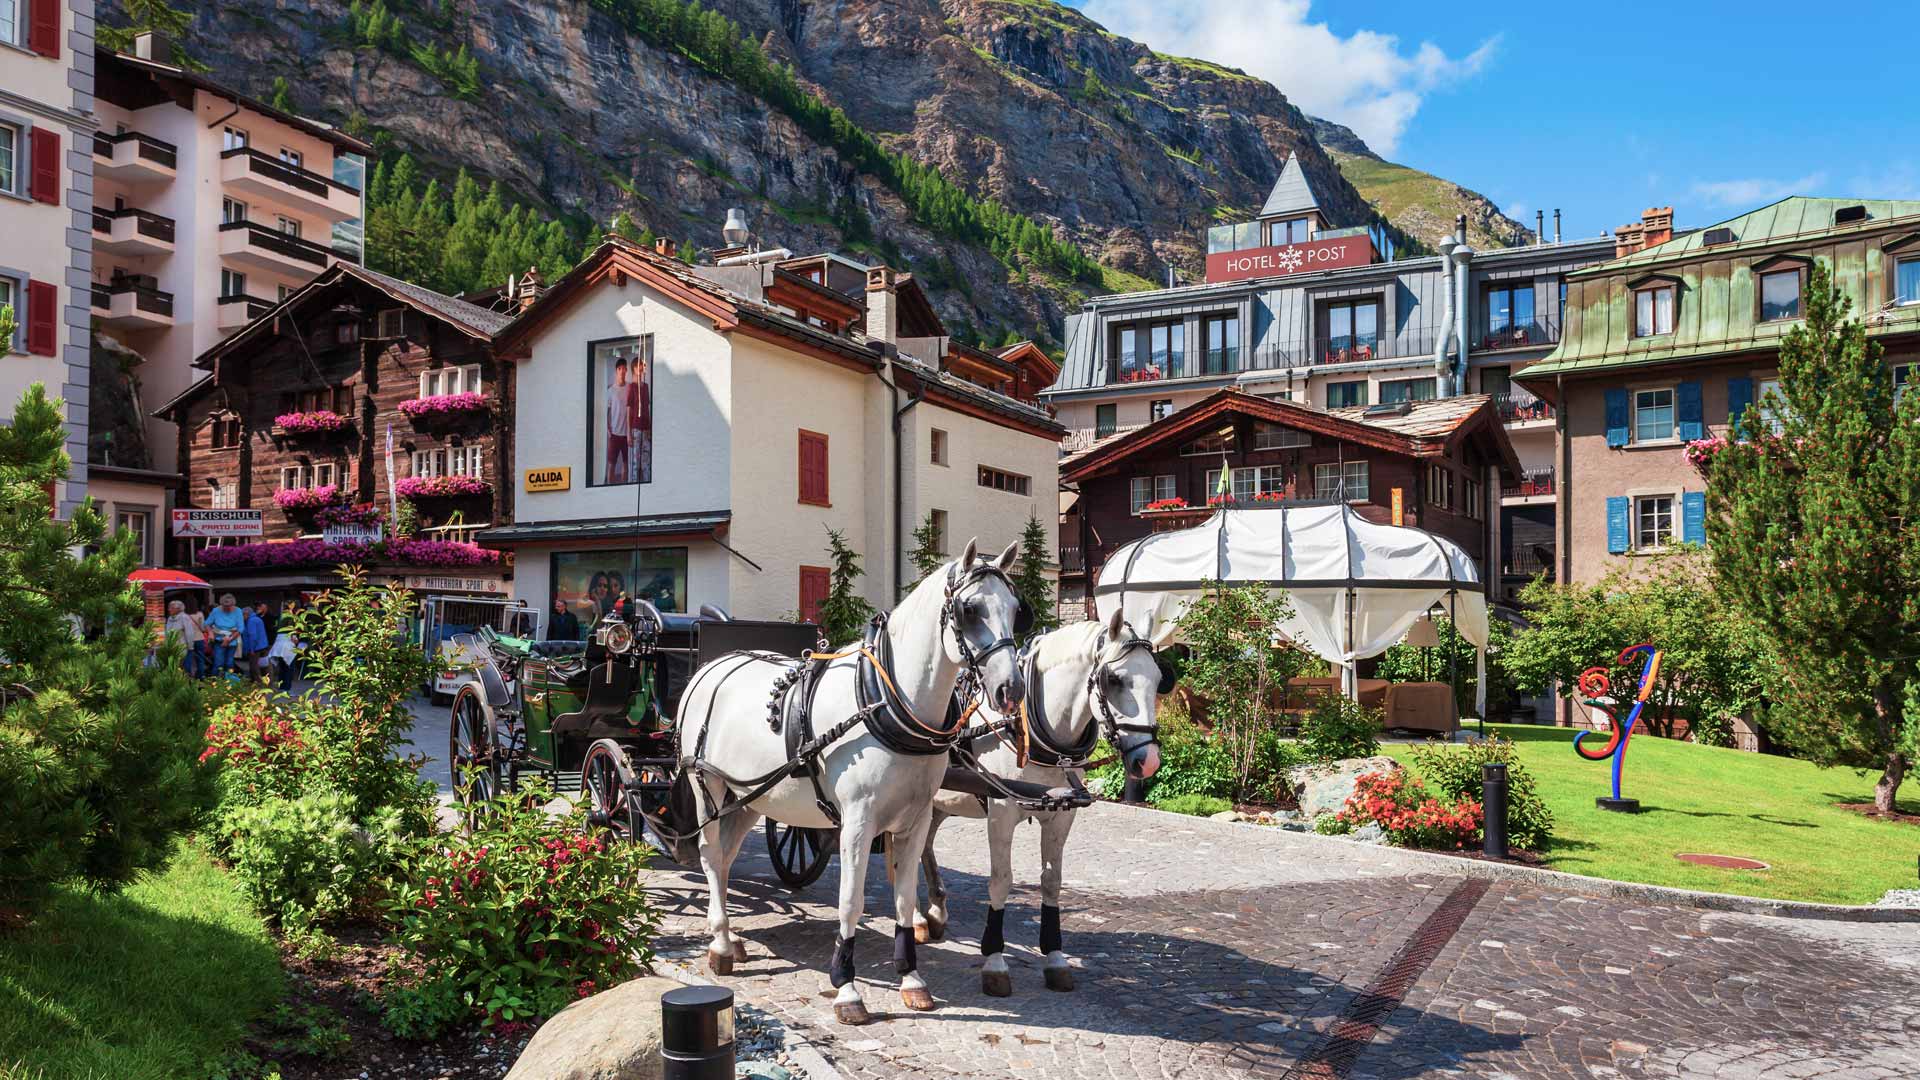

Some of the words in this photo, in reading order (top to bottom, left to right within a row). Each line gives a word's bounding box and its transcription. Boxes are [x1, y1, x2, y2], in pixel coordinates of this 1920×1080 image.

[1227, 255, 1275, 272] HOTEL
[1307, 246, 1347, 262] POST
[528, 471, 563, 483] CALIDA
[192, 511, 259, 520] SKISCHULE
[425, 577, 463, 590] MATTERHORN
[466, 579, 484, 591] SPORT
